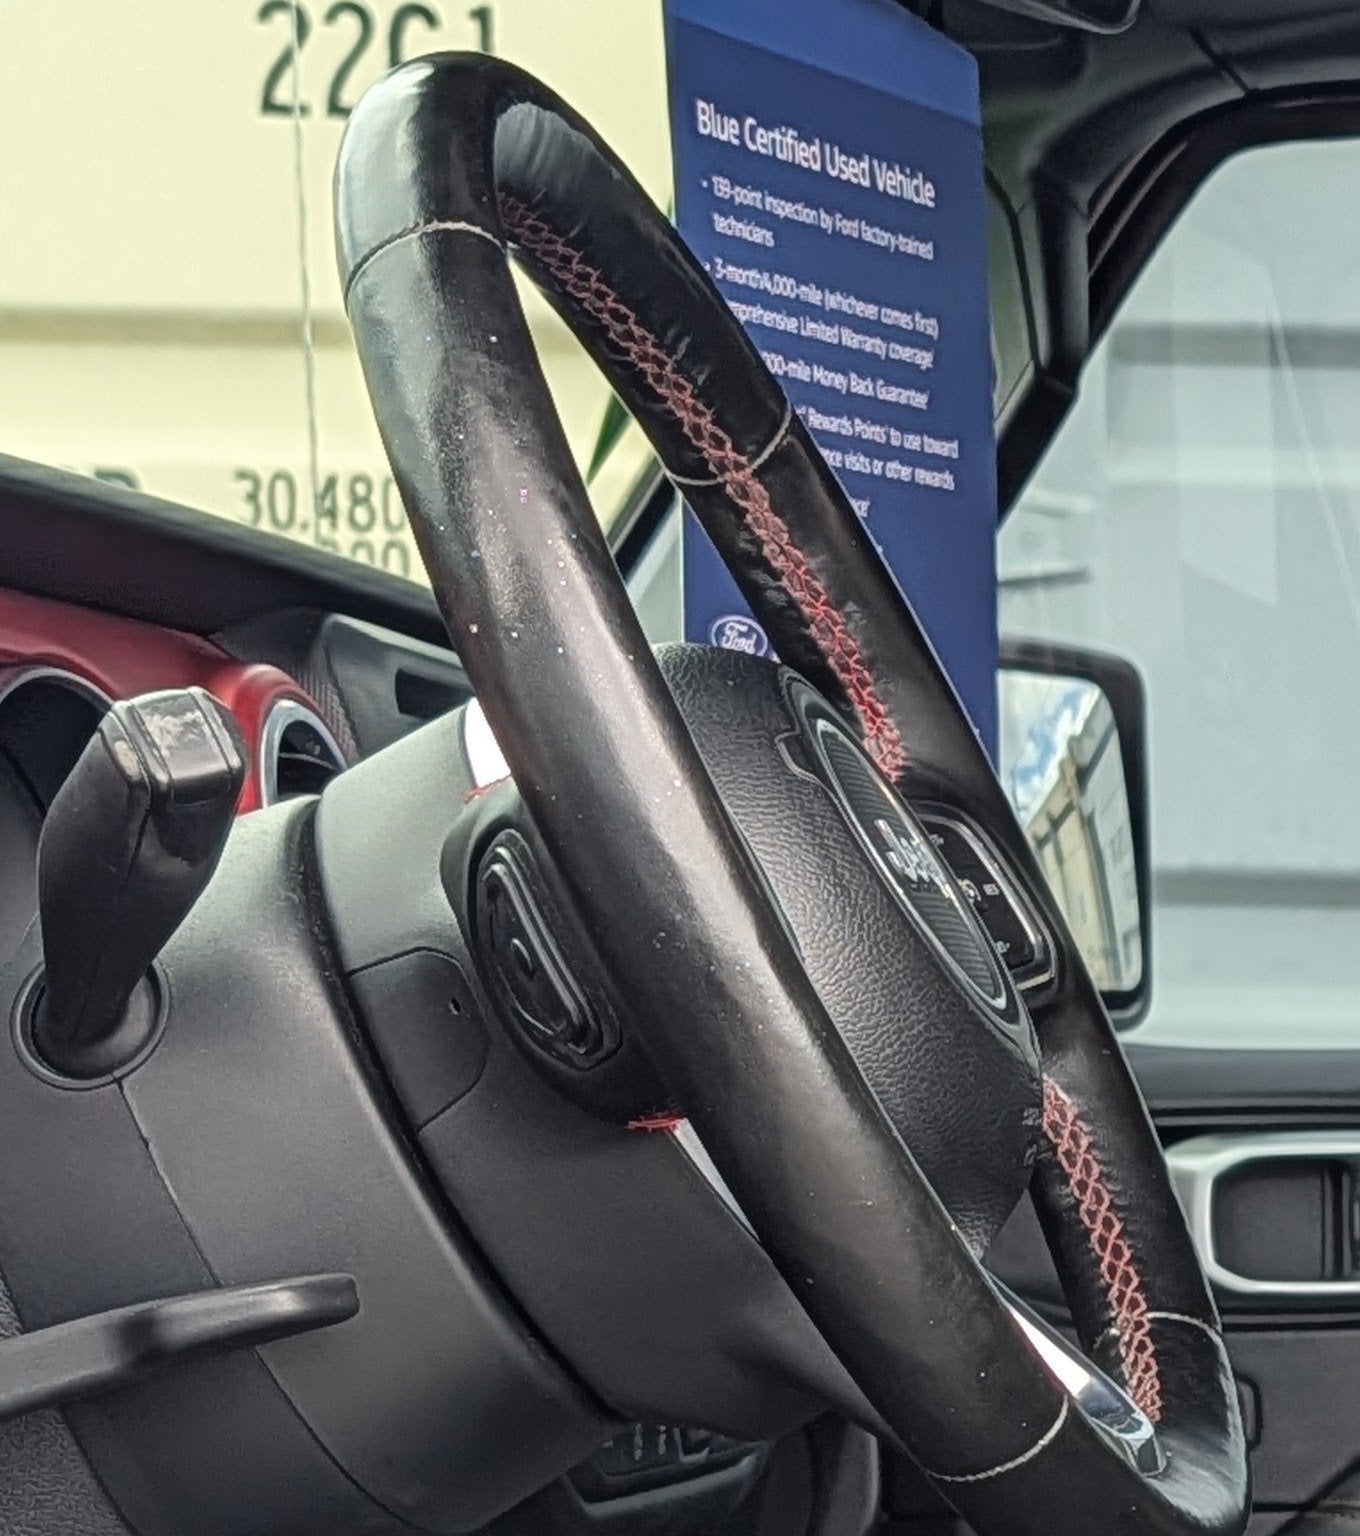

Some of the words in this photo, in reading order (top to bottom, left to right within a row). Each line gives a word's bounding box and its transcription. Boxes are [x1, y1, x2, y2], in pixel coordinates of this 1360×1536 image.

[696, 98, 740, 146] Blue
[743, 116, 821, 172] Certified
[824, 141, 870, 188] Used
[871, 156, 936, 208] Vehicle
[765, 190, 819, 225] inspection
[819, 207, 834, 234] by
[834, 213, 859, 239] Ford
[861, 220, 935, 261] factory-trained
[880, 306, 915, 331] comes
[799, 315, 840, 345] Limited
[840, 325, 887, 361] Warranty
[812, 363, 848, 395] Money
[849, 372, 875, 397] Back
[889, 427, 902, 448] to
[902, 432, 922, 452] use
[872, 459, 885, 476] or
[885, 459, 915, 483] other
[720, 622, 757, 653] Ford
